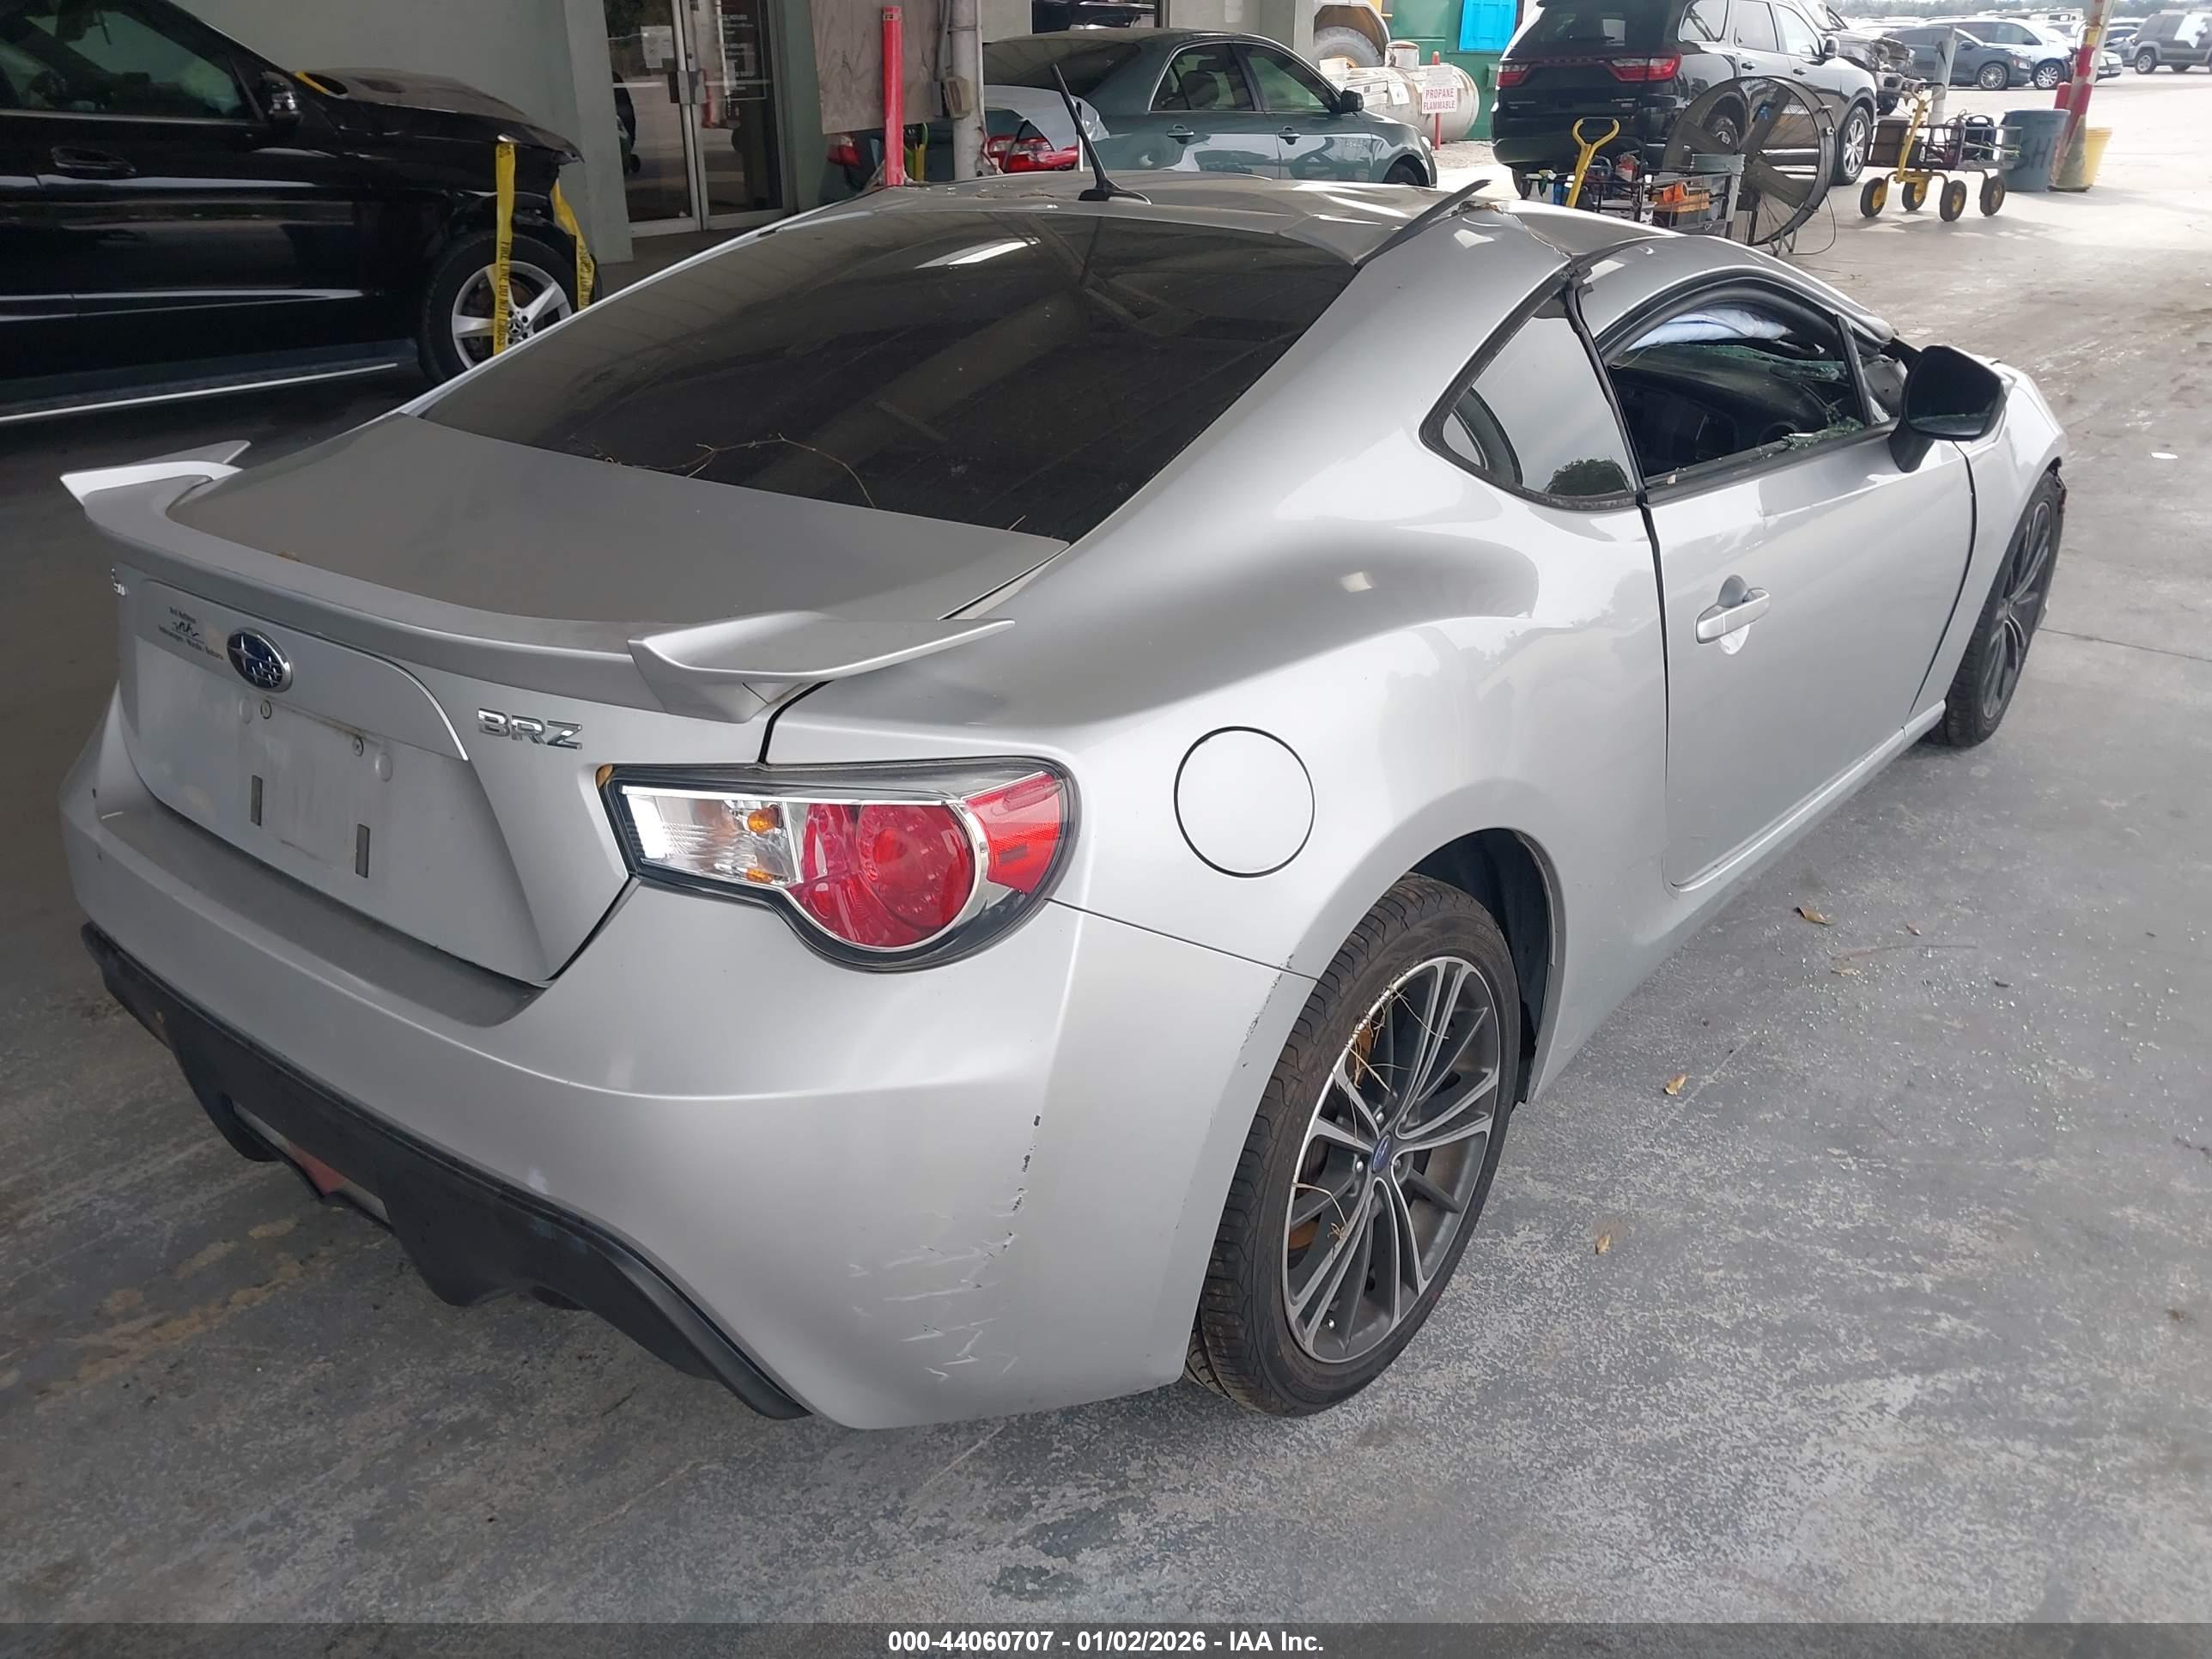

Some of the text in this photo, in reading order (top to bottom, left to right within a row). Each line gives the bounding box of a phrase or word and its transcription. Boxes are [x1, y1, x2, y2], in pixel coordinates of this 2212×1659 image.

[1425, 88, 1455, 99] PROPANE
[1423, 100, 1455, 111] FLAMMABLE
[477, 708, 583, 750] BRZ
